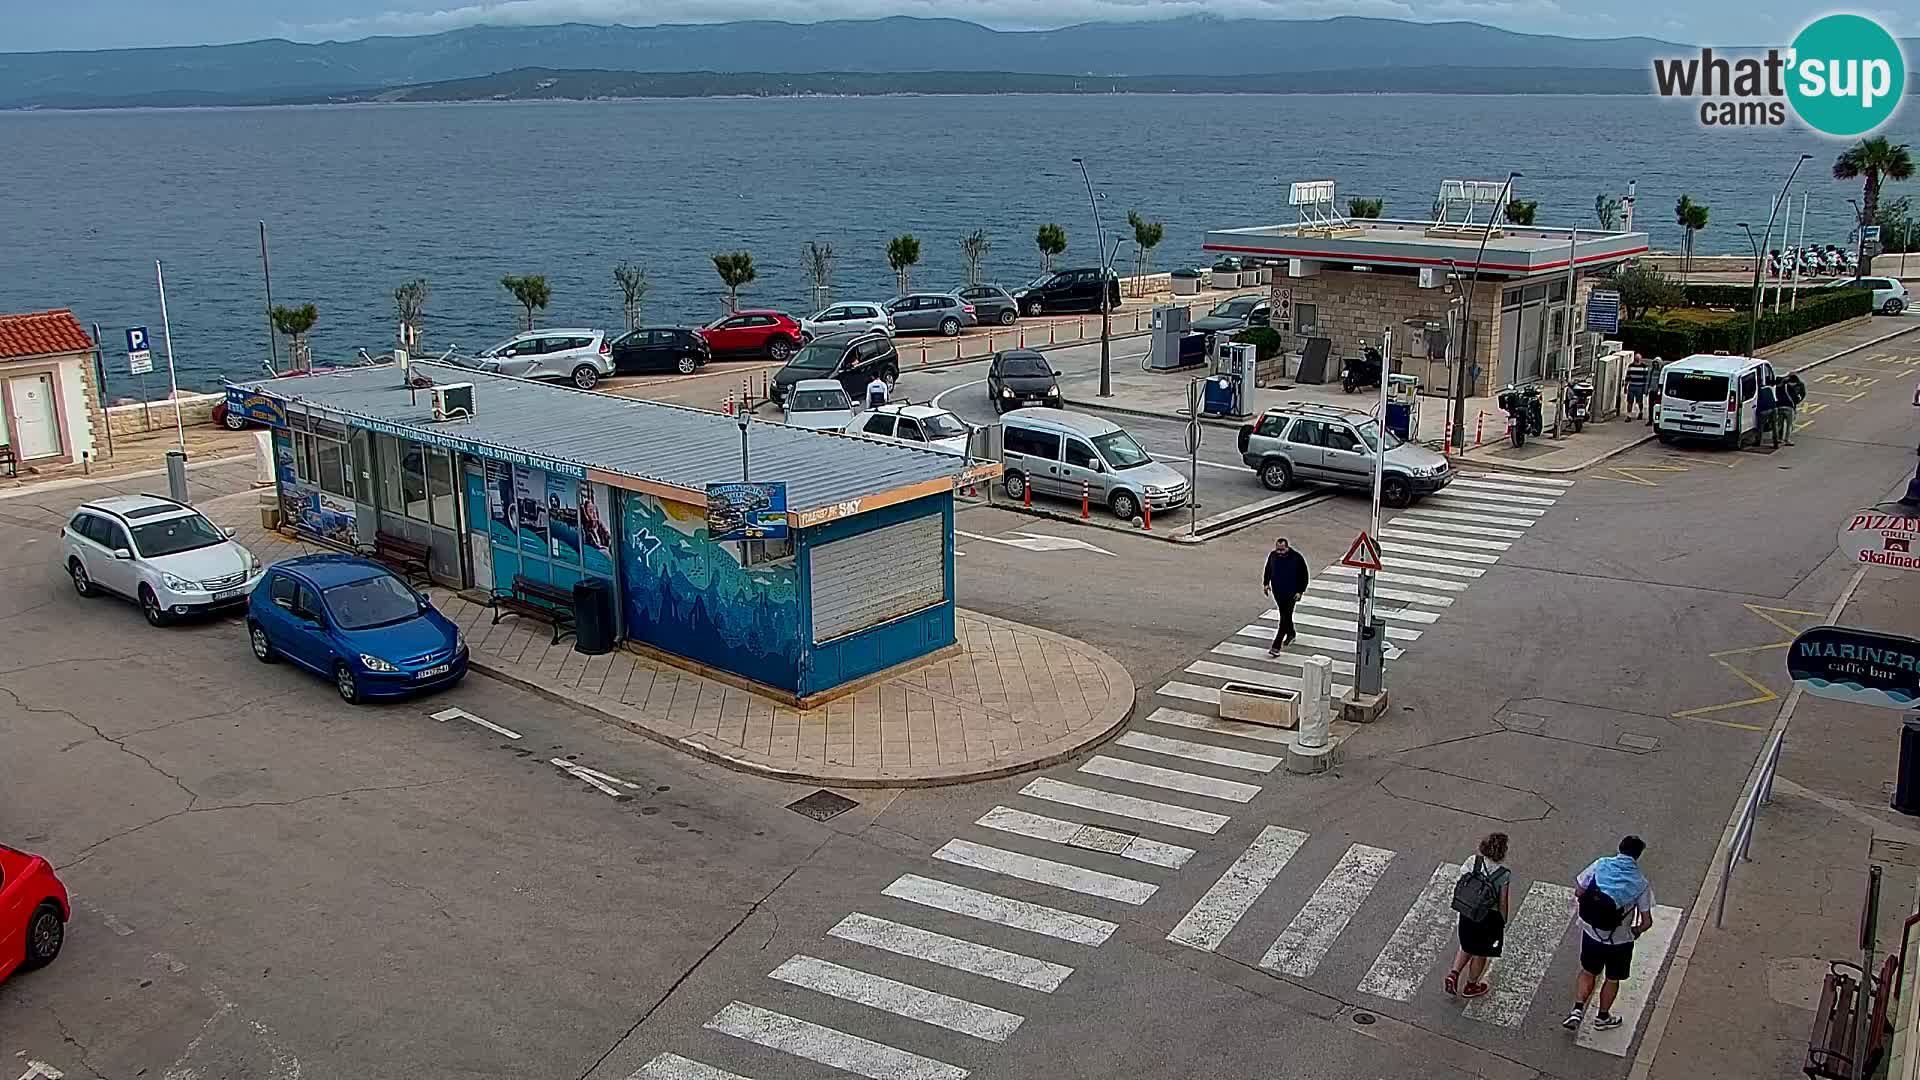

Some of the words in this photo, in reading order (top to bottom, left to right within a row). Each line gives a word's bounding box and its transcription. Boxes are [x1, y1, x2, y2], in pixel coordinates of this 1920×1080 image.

[131, 330, 143, 349] P
[1814, 374, 1880, 387] TAXI
[396, 425, 437, 444] AUTOBUSNA
[437, 435, 469, 451] POSTAJA
[478, 445, 493, 457] BUS
[494, 449, 527, 464] STATION
[528, 456, 555, 471] TICKET
[555, 462, 583, 477] OFFICE
[1881, 530, 1916, 540] GRILL
[1828, 662, 1865, 674] caffe
[1870, 665, 1896, 680] bar
